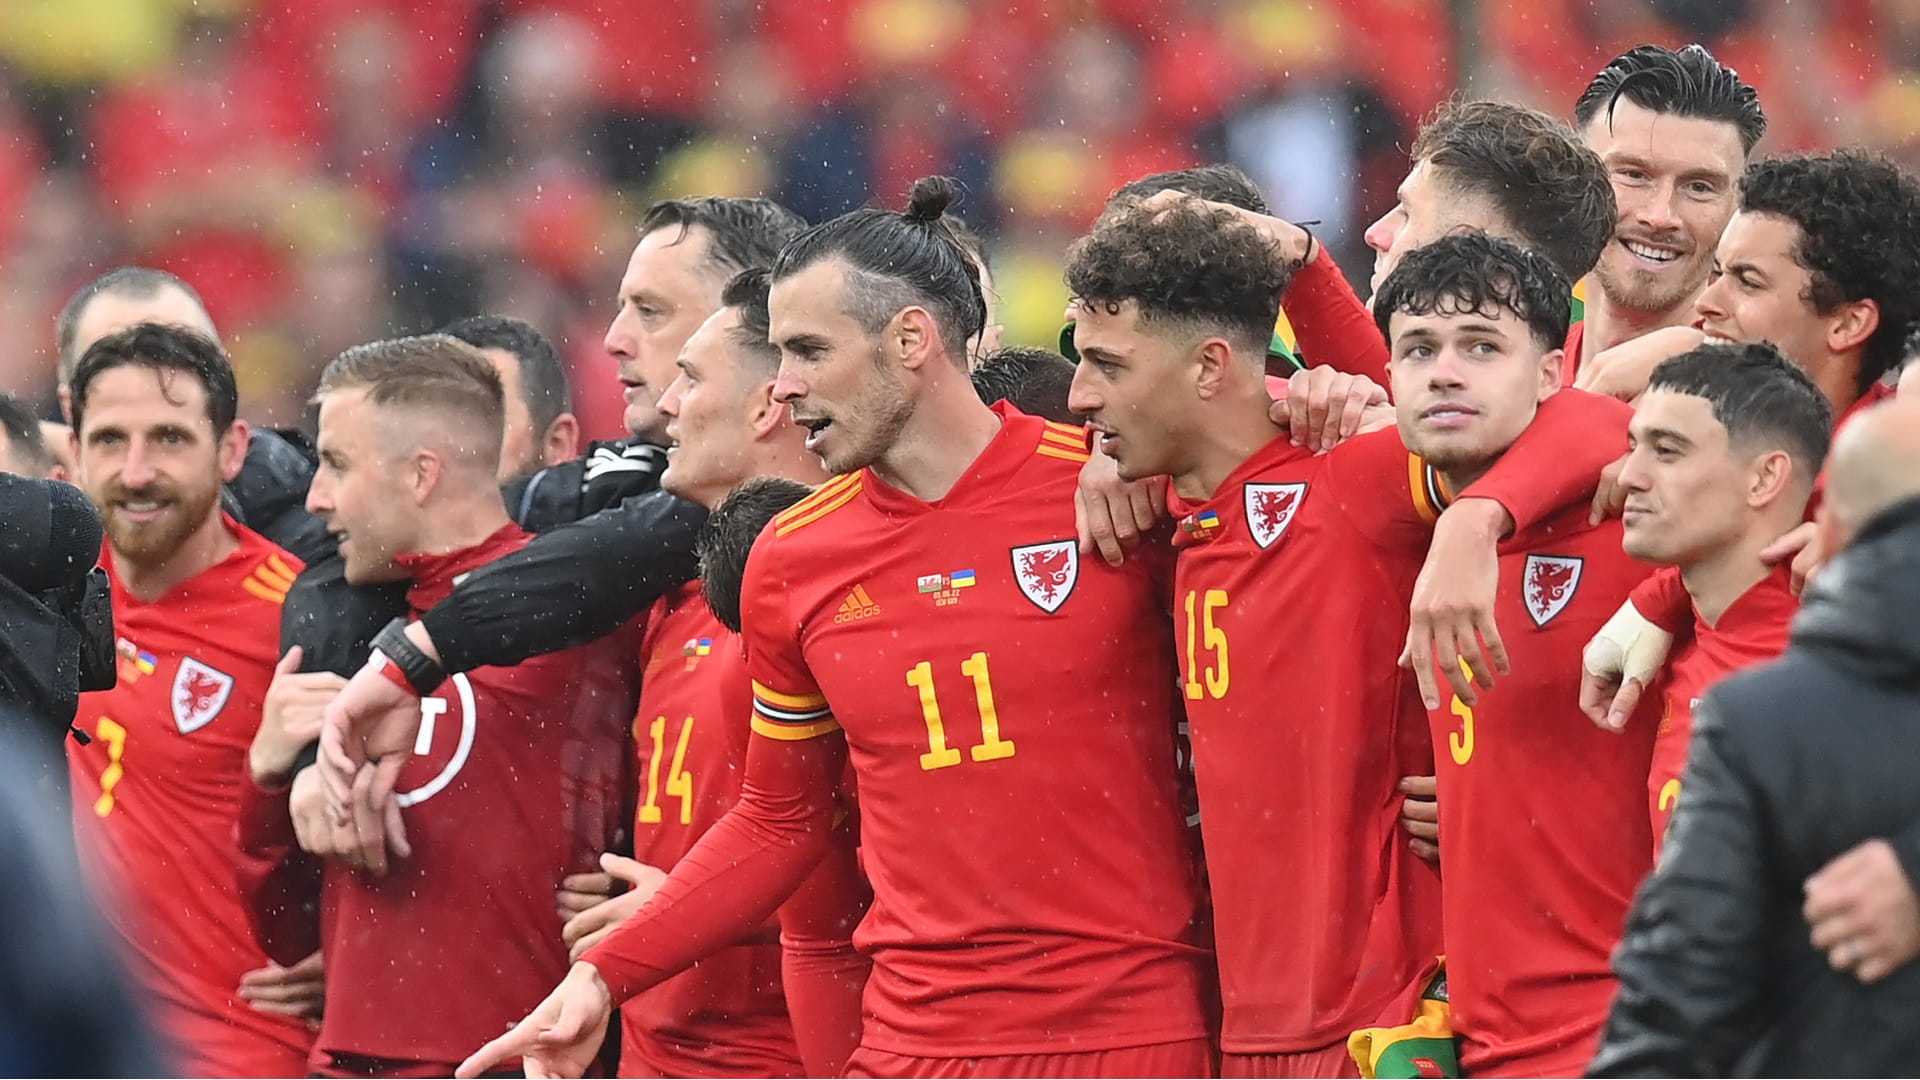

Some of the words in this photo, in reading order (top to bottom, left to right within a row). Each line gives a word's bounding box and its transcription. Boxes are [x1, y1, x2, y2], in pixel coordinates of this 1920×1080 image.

[833, 604, 881, 624] adidas
[1185, 590, 1230, 699] 15
[906, 652, 1016, 771] 11
[93, 716, 127, 817] 7
[638, 716, 694, 825] 14
